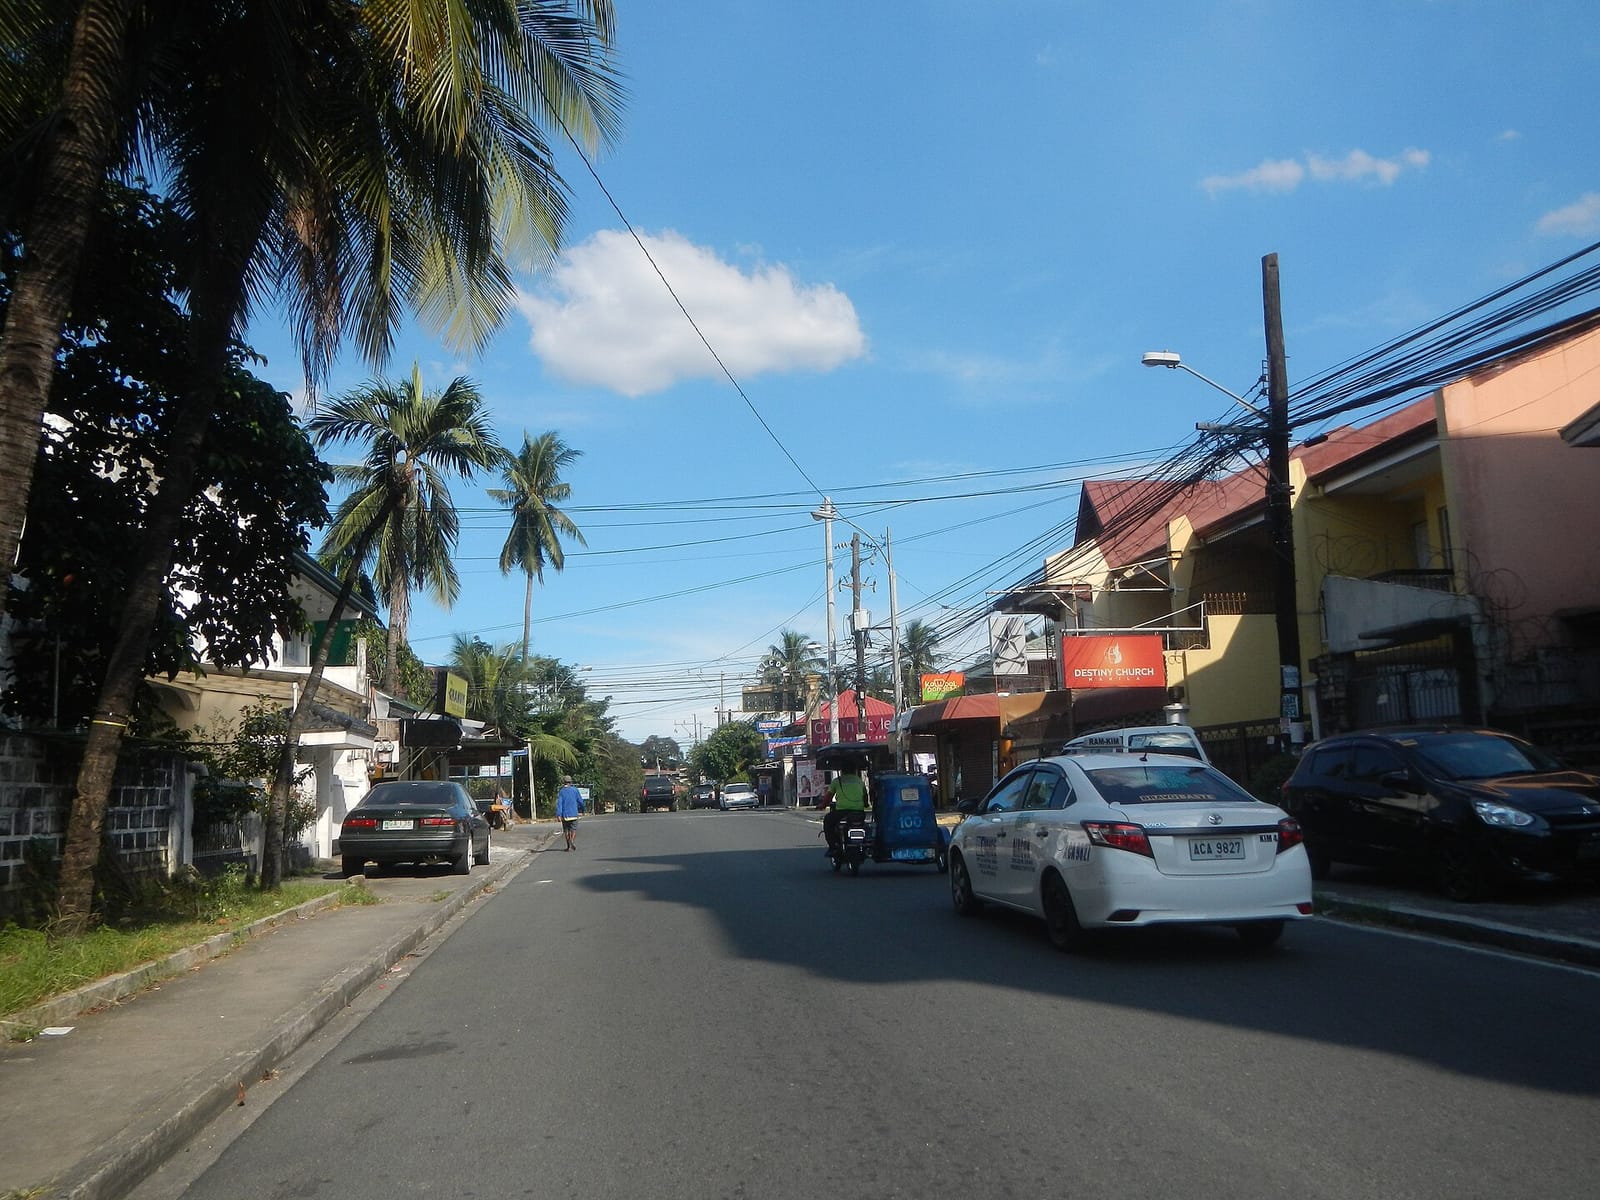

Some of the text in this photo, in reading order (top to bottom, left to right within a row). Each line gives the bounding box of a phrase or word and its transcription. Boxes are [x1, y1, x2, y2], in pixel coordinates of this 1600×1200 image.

[1074, 667, 1154, 677] DESTINY CHURCH
[1088, 736, 1120, 746] RAM-KIM
[898, 815, 922, 829] 100
[1259, 834, 1273, 842] KIM
[1193, 842, 1241, 855] ACA 9827
